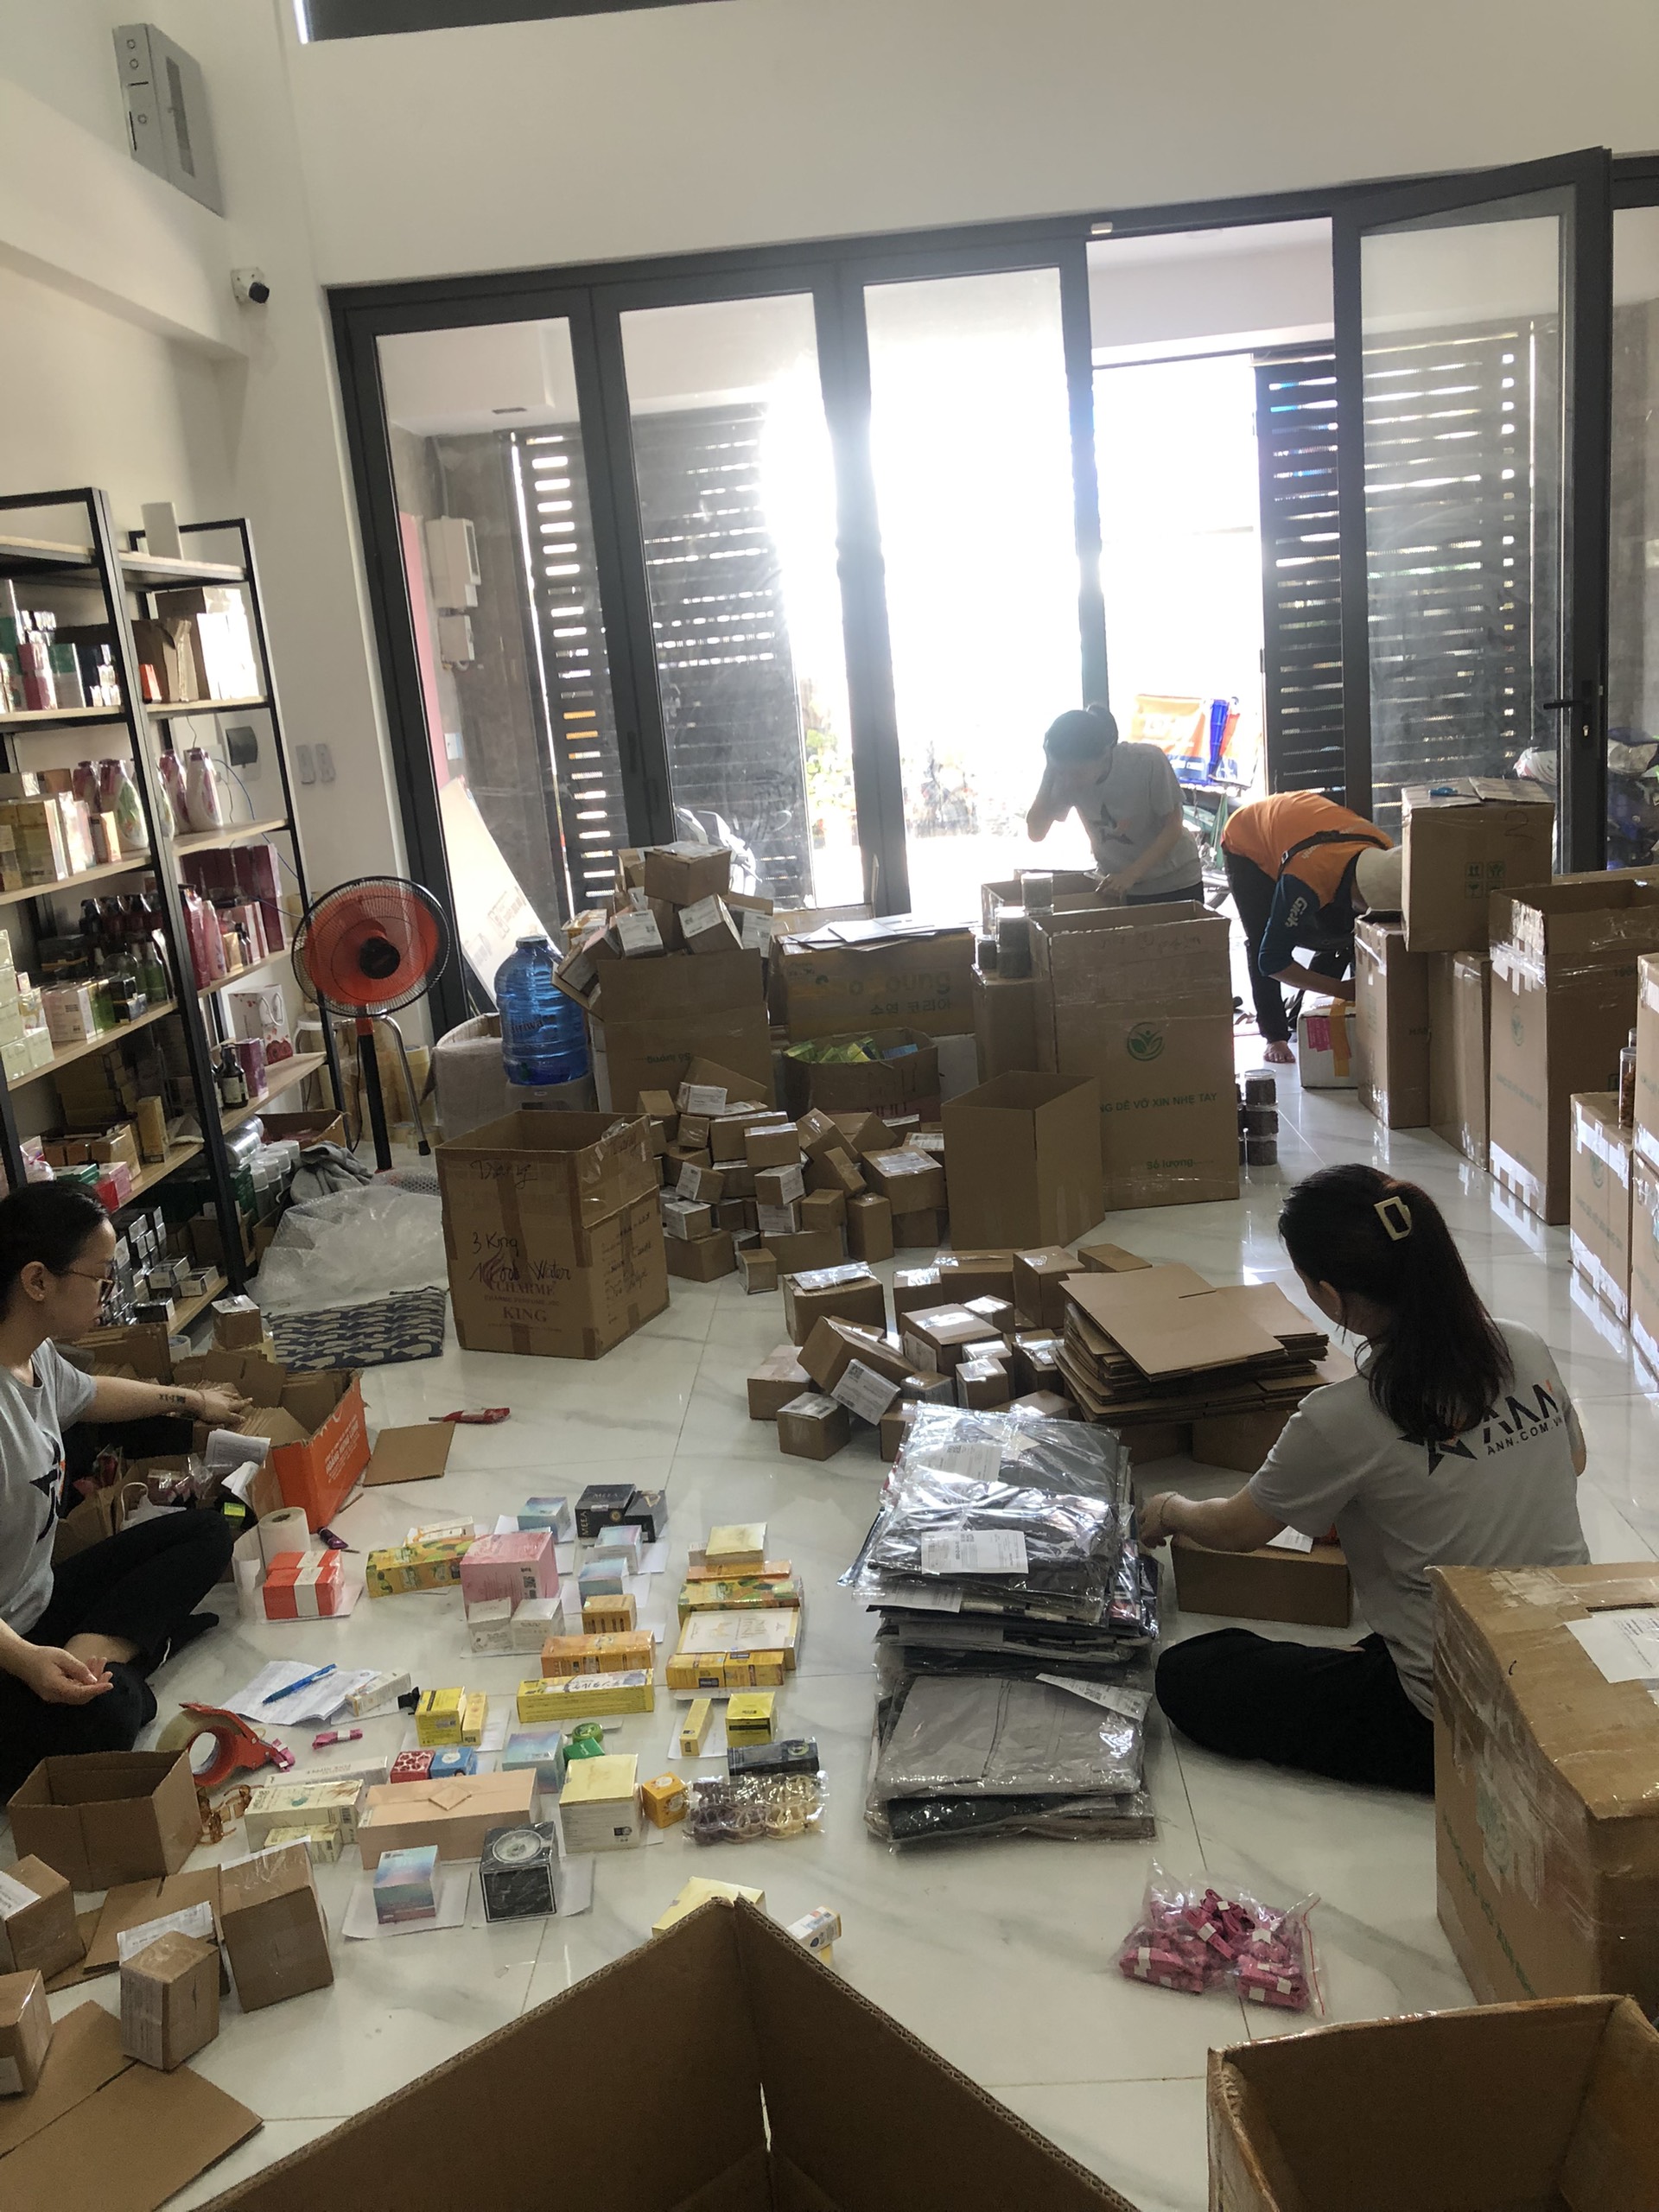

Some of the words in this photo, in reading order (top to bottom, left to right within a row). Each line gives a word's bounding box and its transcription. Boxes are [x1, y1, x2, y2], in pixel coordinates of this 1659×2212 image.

[1152, 1098, 1170, 1108] XIN
[1198, 1092, 1217, 1102] TAY
[496, 1282, 556, 1296] CHARME
[503, 1306, 547, 1323] KING
[581, 1510, 590, 1535] MEEA
